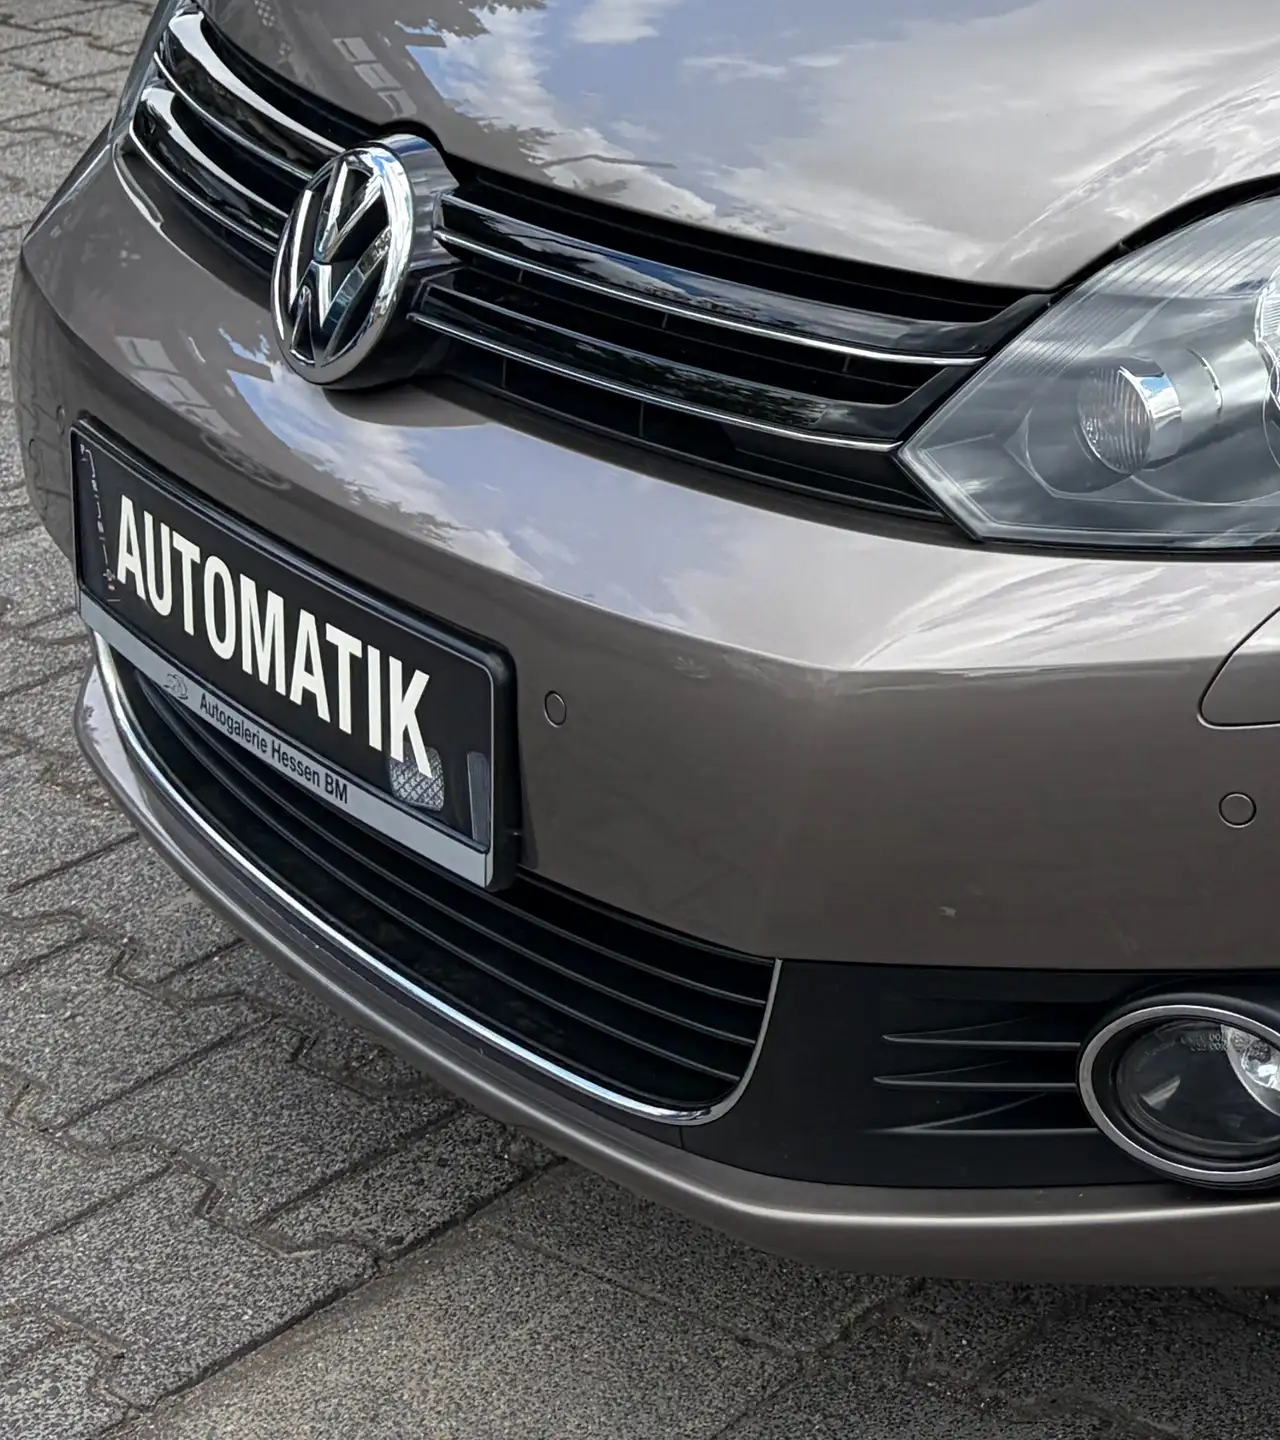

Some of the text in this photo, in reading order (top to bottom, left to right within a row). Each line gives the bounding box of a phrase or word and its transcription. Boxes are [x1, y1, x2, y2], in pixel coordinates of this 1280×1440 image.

[116, 494, 432, 779] AUTOMATIK
[199, 692, 349, 805] Autogalerie Hessen BM
